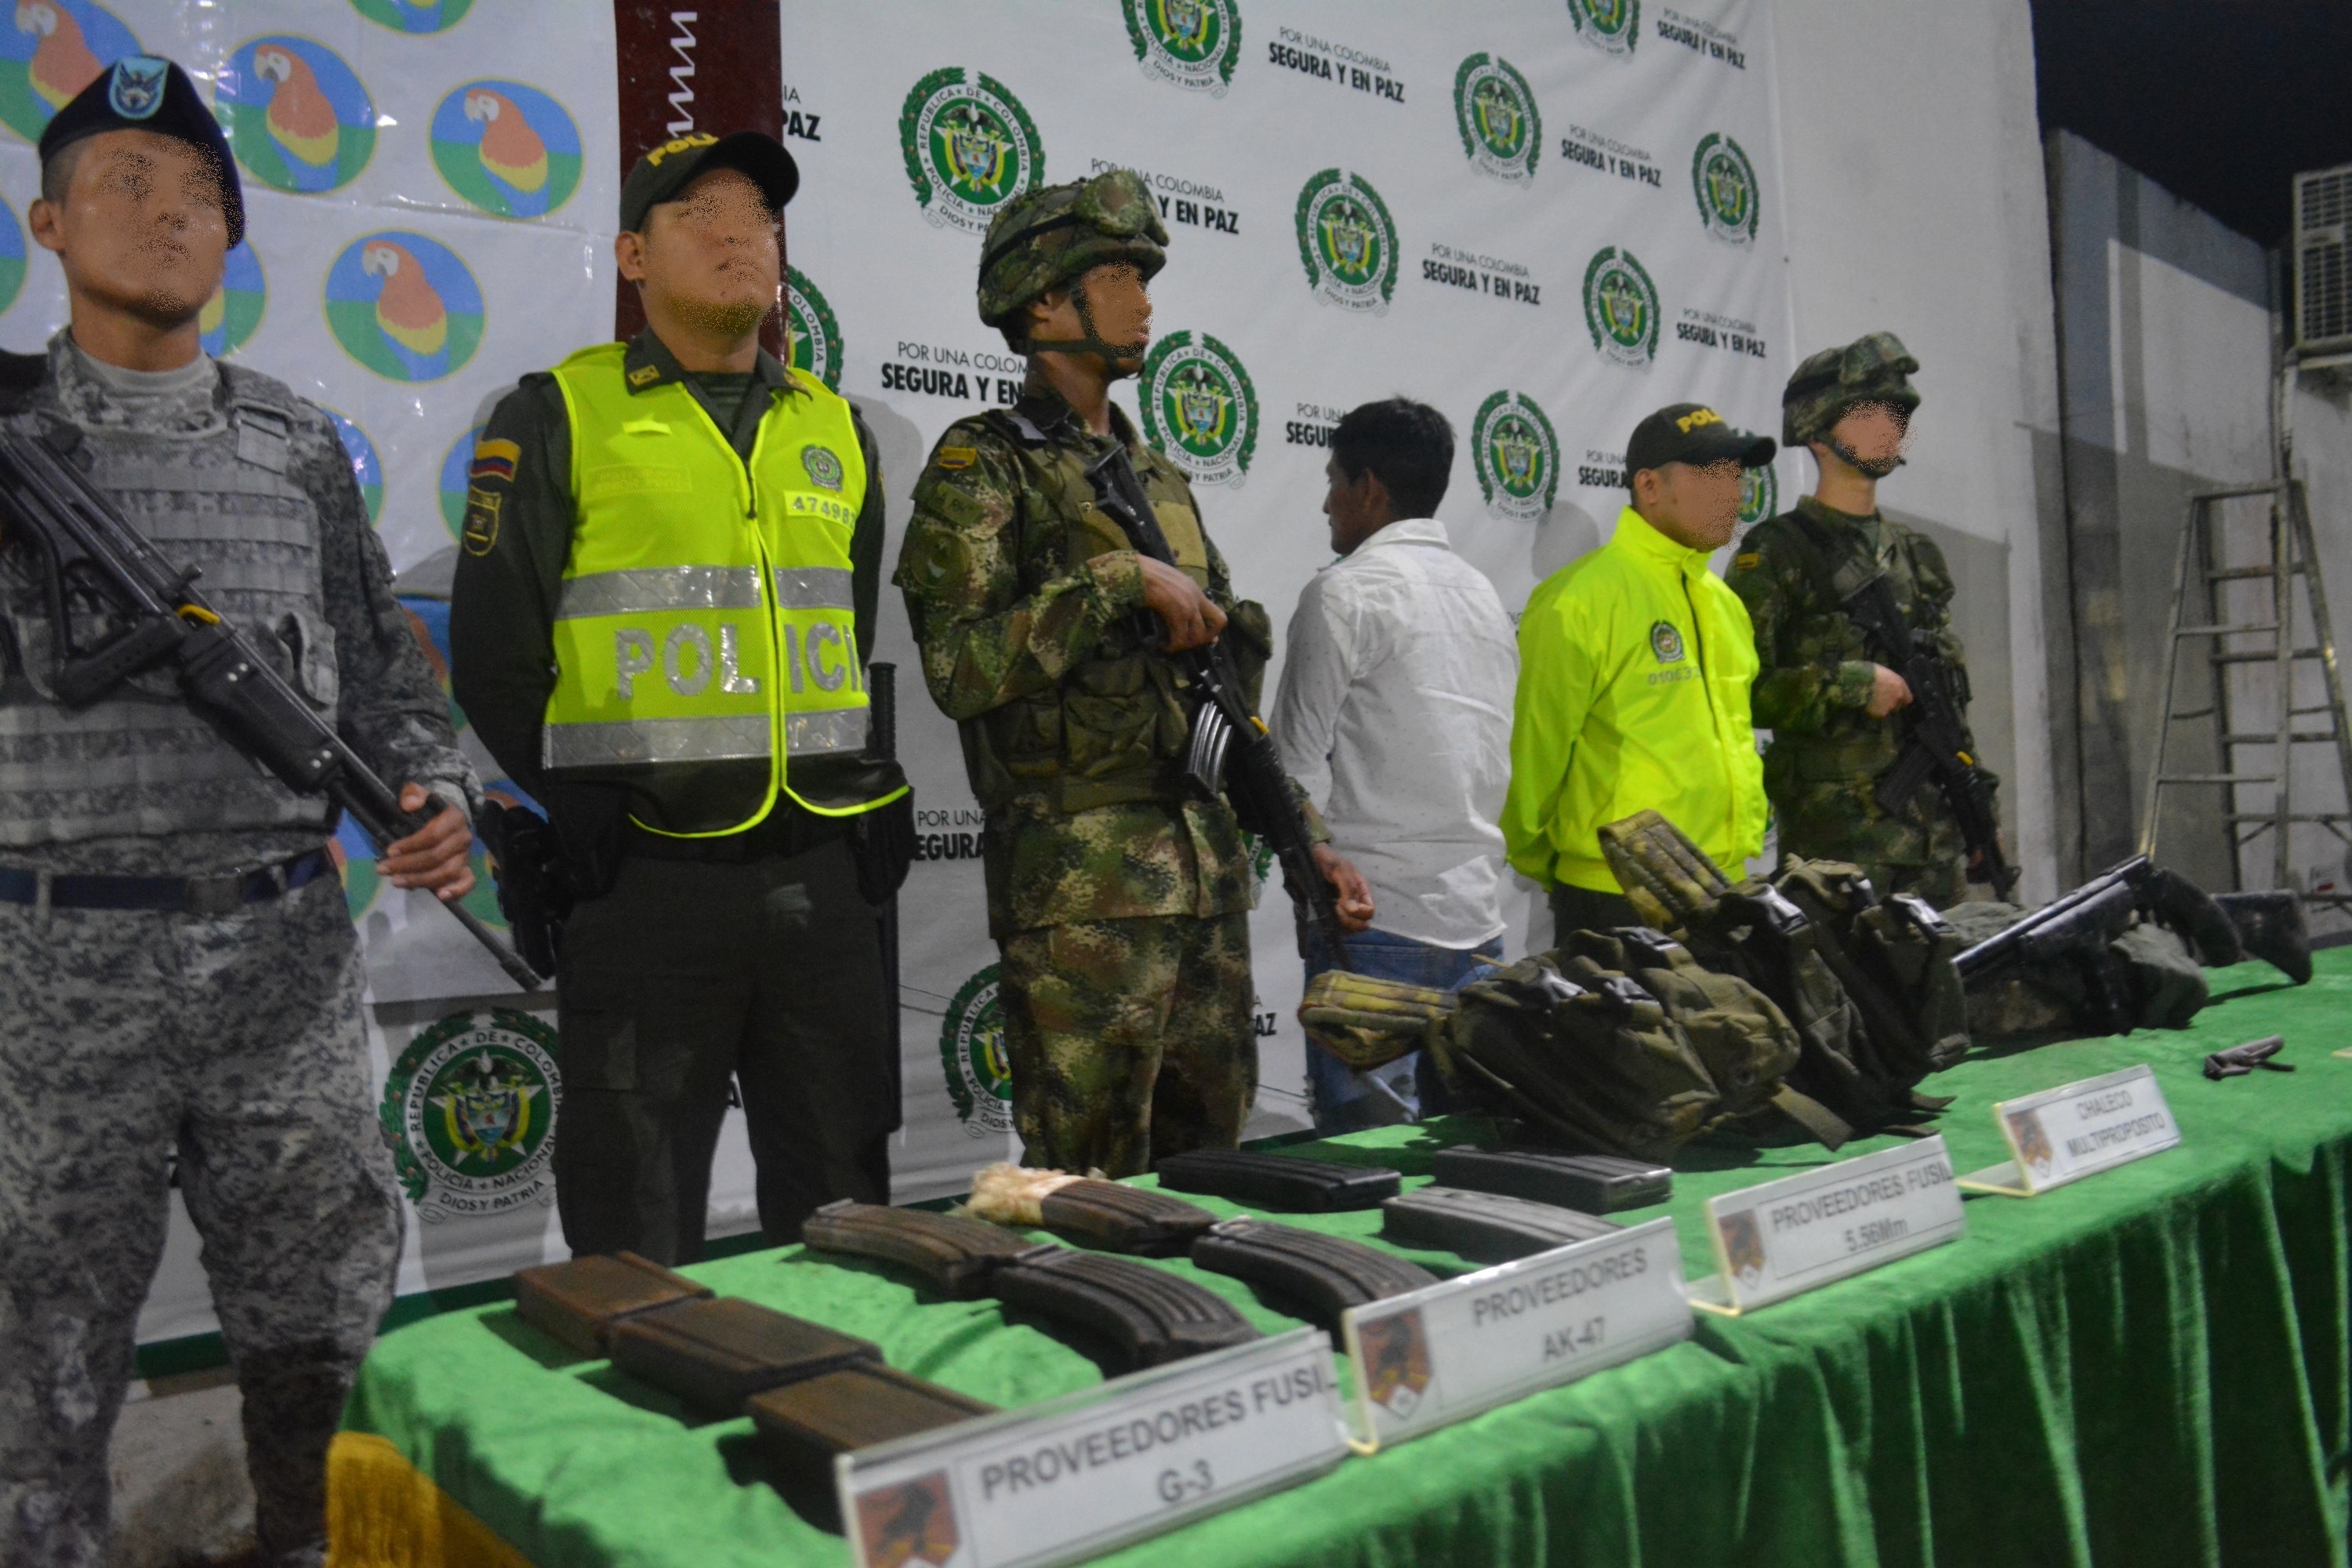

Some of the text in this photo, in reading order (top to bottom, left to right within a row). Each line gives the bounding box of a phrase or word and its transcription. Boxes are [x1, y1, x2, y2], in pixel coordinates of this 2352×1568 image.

[1142, 24, 1224, 72] POLICIA NACIONAL
[1279, 26, 1392, 74] POR UNA COLOMBIA
[1657, 20, 1699, 52] SEGURA
[1701, 37, 1708, 55] Y
[1727, 46, 1747, 70] PAZ
[1185, 76, 1214, 88] PATRIA
[1269, 42, 1405, 103] SEGURA Y EN PAZ
[918, 87, 1029, 172] REPUBLICA DE COLOMBIA
[1562, 138, 1661, 187] SEGURA Y EN PAZ
[926, 166, 964, 211] POLICIA
[1156, 173, 1225, 203] COLOMBIA
[939, 205, 966, 227] DIOS
[1157, 194, 1240, 235] Y EN PAZ
[1310, 184, 1387, 256] REPUBLICA DE COLOMBIA
[1315, 253, 1385, 296] POLICIA NACIONAL
[1422, 259, 1541, 306] SEGURA Y EN PAZ
[1432, 242, 1530, 278] POR UNA COLOMBIA
[1352, 298, 1378, 309] PATRIA
[898, 341, 930, 361] POR
[935, 346, 971, 367] UNA
[1676, 321, 1767, 358] SEGURA Y EN PAZ
[881, 361, 970, 400] SEGURA
[975, 375, 990, 401] Y
[1154, 347, 1246, 423] REPUBLICA DE COLOMBIA
[1297, 402, 1320, 419] POR
[1160, 426, 1243, 468] POLICIA NACIONAL
[1203, 468, 1233, 482] PATRIA
[916, 810, 950, 827] POR
[960, 989, 993, 1063] REPUBLICA
[409, 1044, 459, 1132] REPUBLICA
[475, 1032, 498, 1044] DE
[967, 1079, 1004, 1112] POLICIA
[2076, 1089, 2133, 1120] CHALECO
[2066, 1112, 2165, 1158] MULTIPROPOSITO
[420, 1134, 556, 1190] POLICIA NACIONAL
[440, 1192, 477, 1211] DIOS
[494, 1179, 546, 1209] PATRIA
[1770, 1160, 1954, 1234] PROVEEDORES FUSIL
[1472, 1247, 1647, 1328] PROVEEDORES
[1543, 1315, 1606, 1363] AK-47
[980, 1388, 1247, 1503] PROVEEDORES
[1156, 1458, 1215, 1504] G-3
